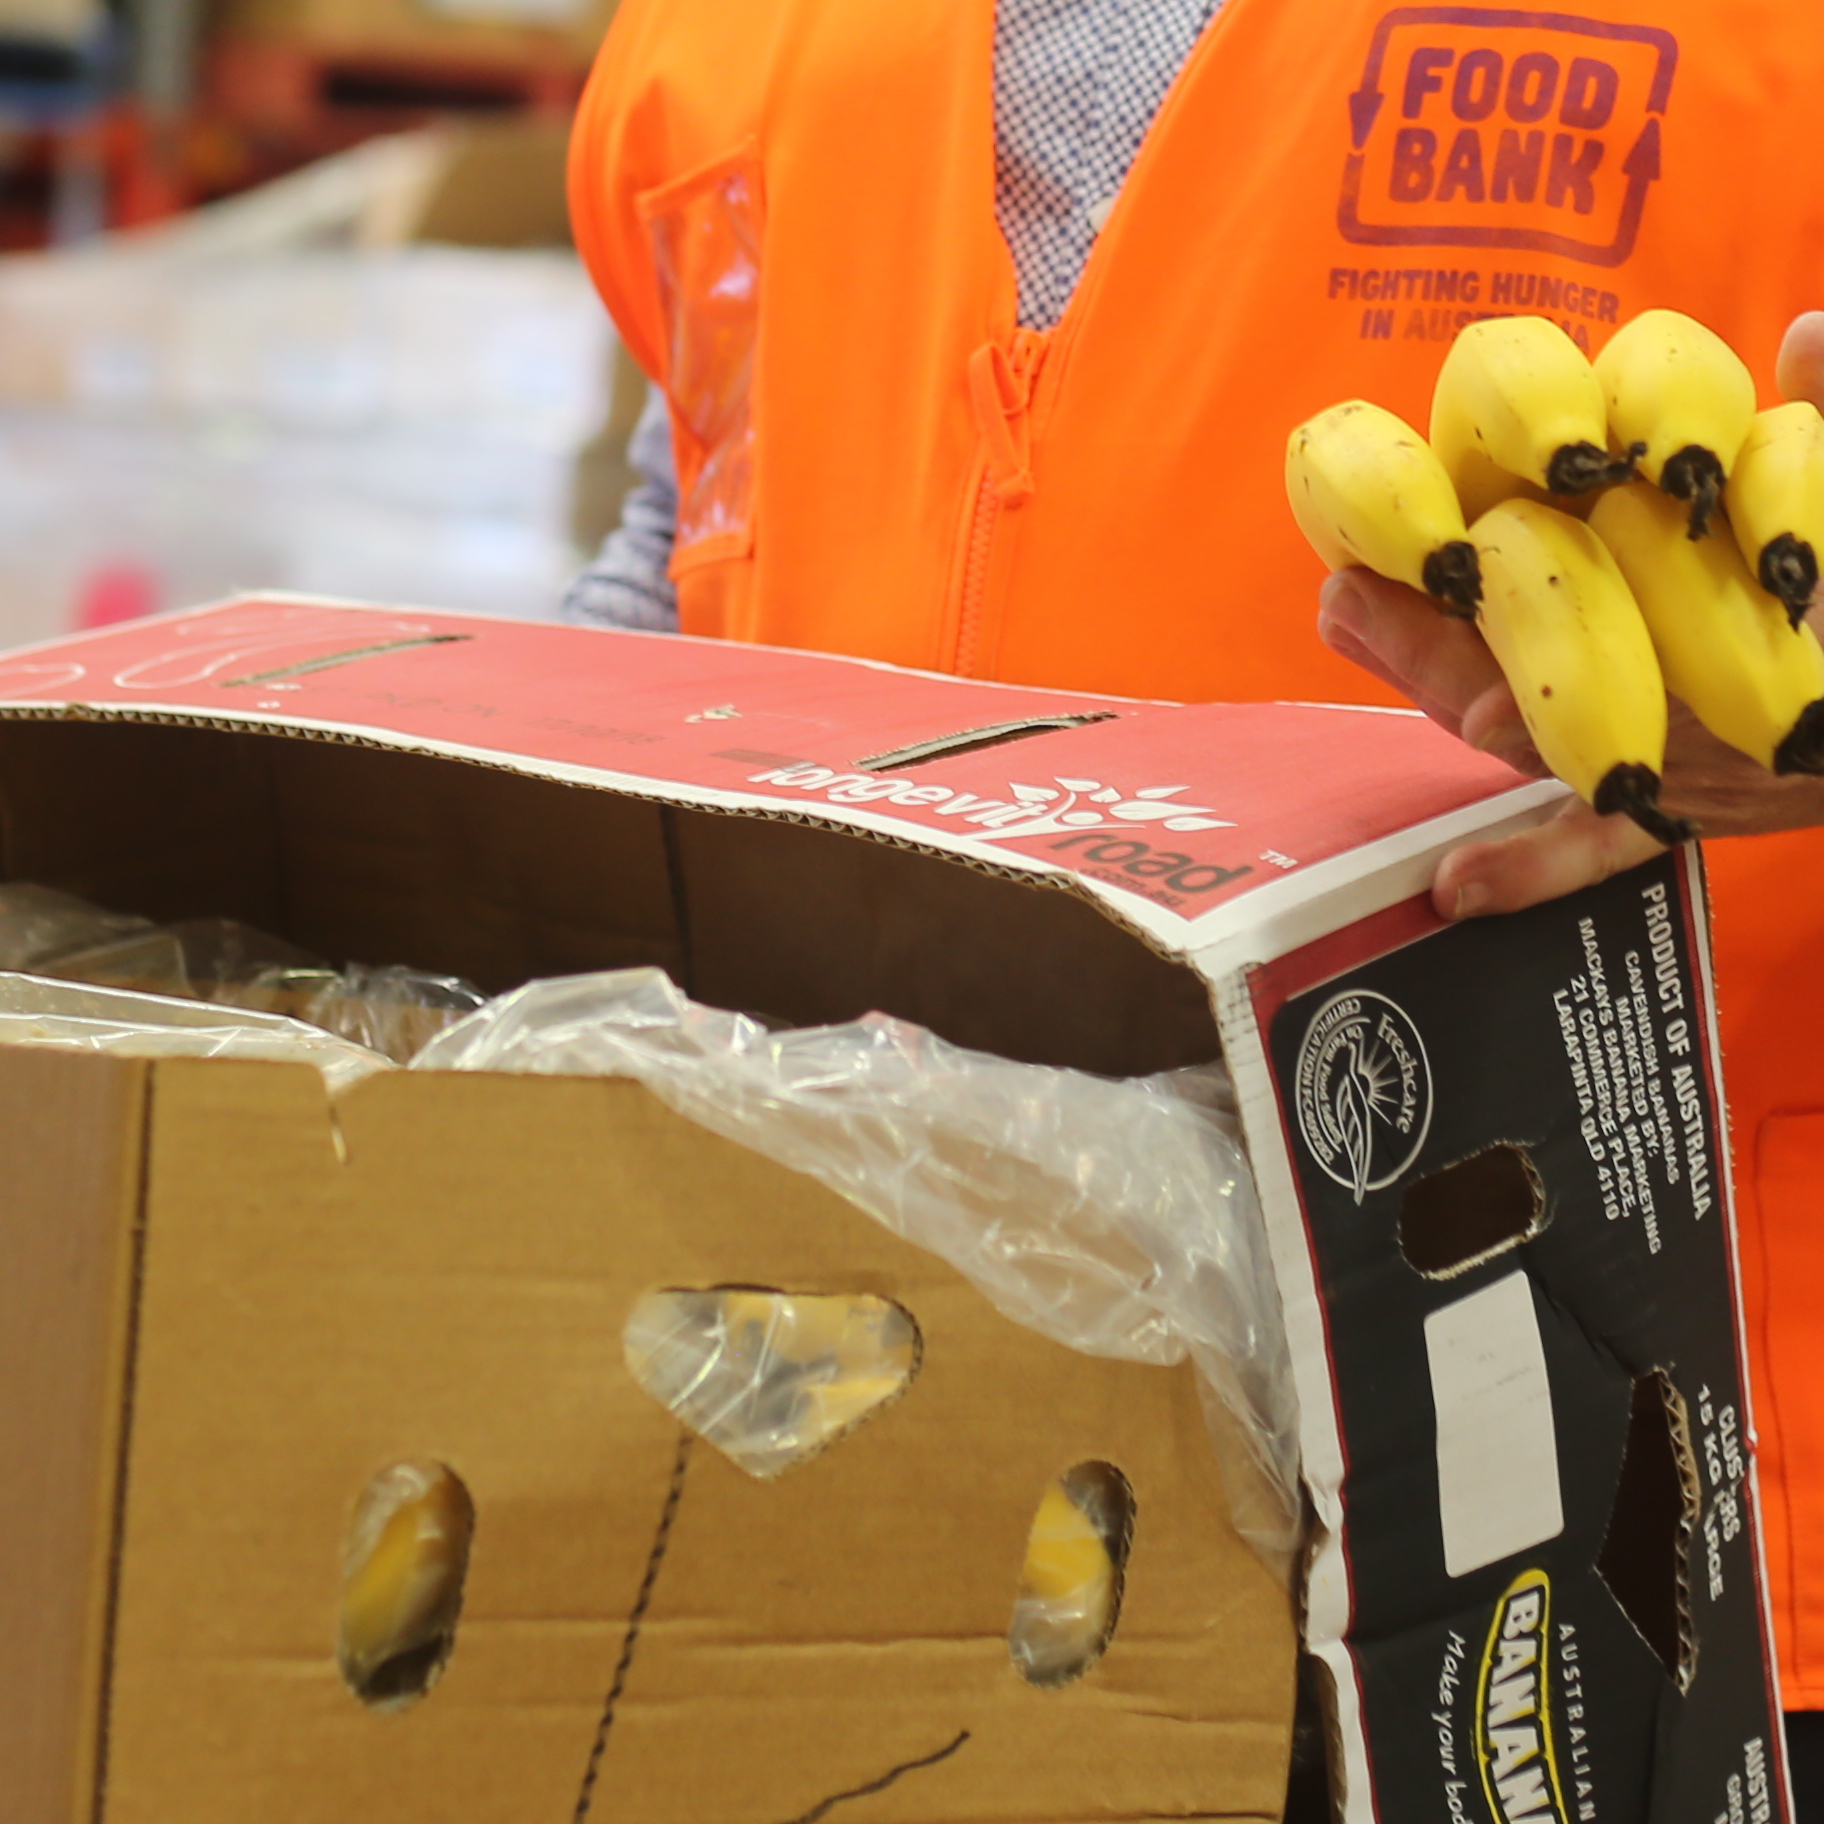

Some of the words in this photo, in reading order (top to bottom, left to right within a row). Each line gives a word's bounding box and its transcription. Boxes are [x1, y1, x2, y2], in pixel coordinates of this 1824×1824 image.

[1402, 47, 1619, 131] FOOD
[1388, 127, 1605, 216] BANK
[1327, 267, 1480, 304] FIGHTING
[1490, 272, 1620, 324] HUNGER
[1360, 309, 1395, 340] IN
[1048, 832, 1255, 896] road
[1569, 974, 1590, 1003] 21
[1641, 881, 1684, 1013] PRODUCT
[1302, 998, 1361, 1086] CERTIFICATION
[1377, 1011, 1418, 1134] Freshcare
[1579, 1007, 1618, 1137] COMMERCE
[1615, 996, 1649, 1116] MARKETED
[1641, 1117, 1660, 1157] BY:
[1625, 949, 1660, 1077] CAVENDISH
[1648, 1078, 1679, 1185] BANANAS
[1665, 1015, 1691, 1056] OF
[1319, 1064, 1332, 1101] Food
[1552, 988, 1594, 1116] LARAPINTA
[1581, 1116, 1606, 1162] QLD
[1597, 1166, 1620, 1220] 4110
[1578, 916, 1614, 1026] MACKAYS
[1603, 1028, 1632, 1124] BANANA
[1623, 1126, 1662, 1255] MARKETING
[1608, 1137, 1637, 1218] PLACE,
[1671, 1064, 1712, 1221] AUSTRALIA
[1698, 1383, 1714, 1426] 15
[1703, 1431, 1723, 1487] KG
[1439, 1630, 1466, 1706] Make
[1431, 1712, 1458, 1776] your
[1558, 1623, 1596, 1821] AUSTRALIAN
[1744, 1736, 1771, 1824] AUSTR
